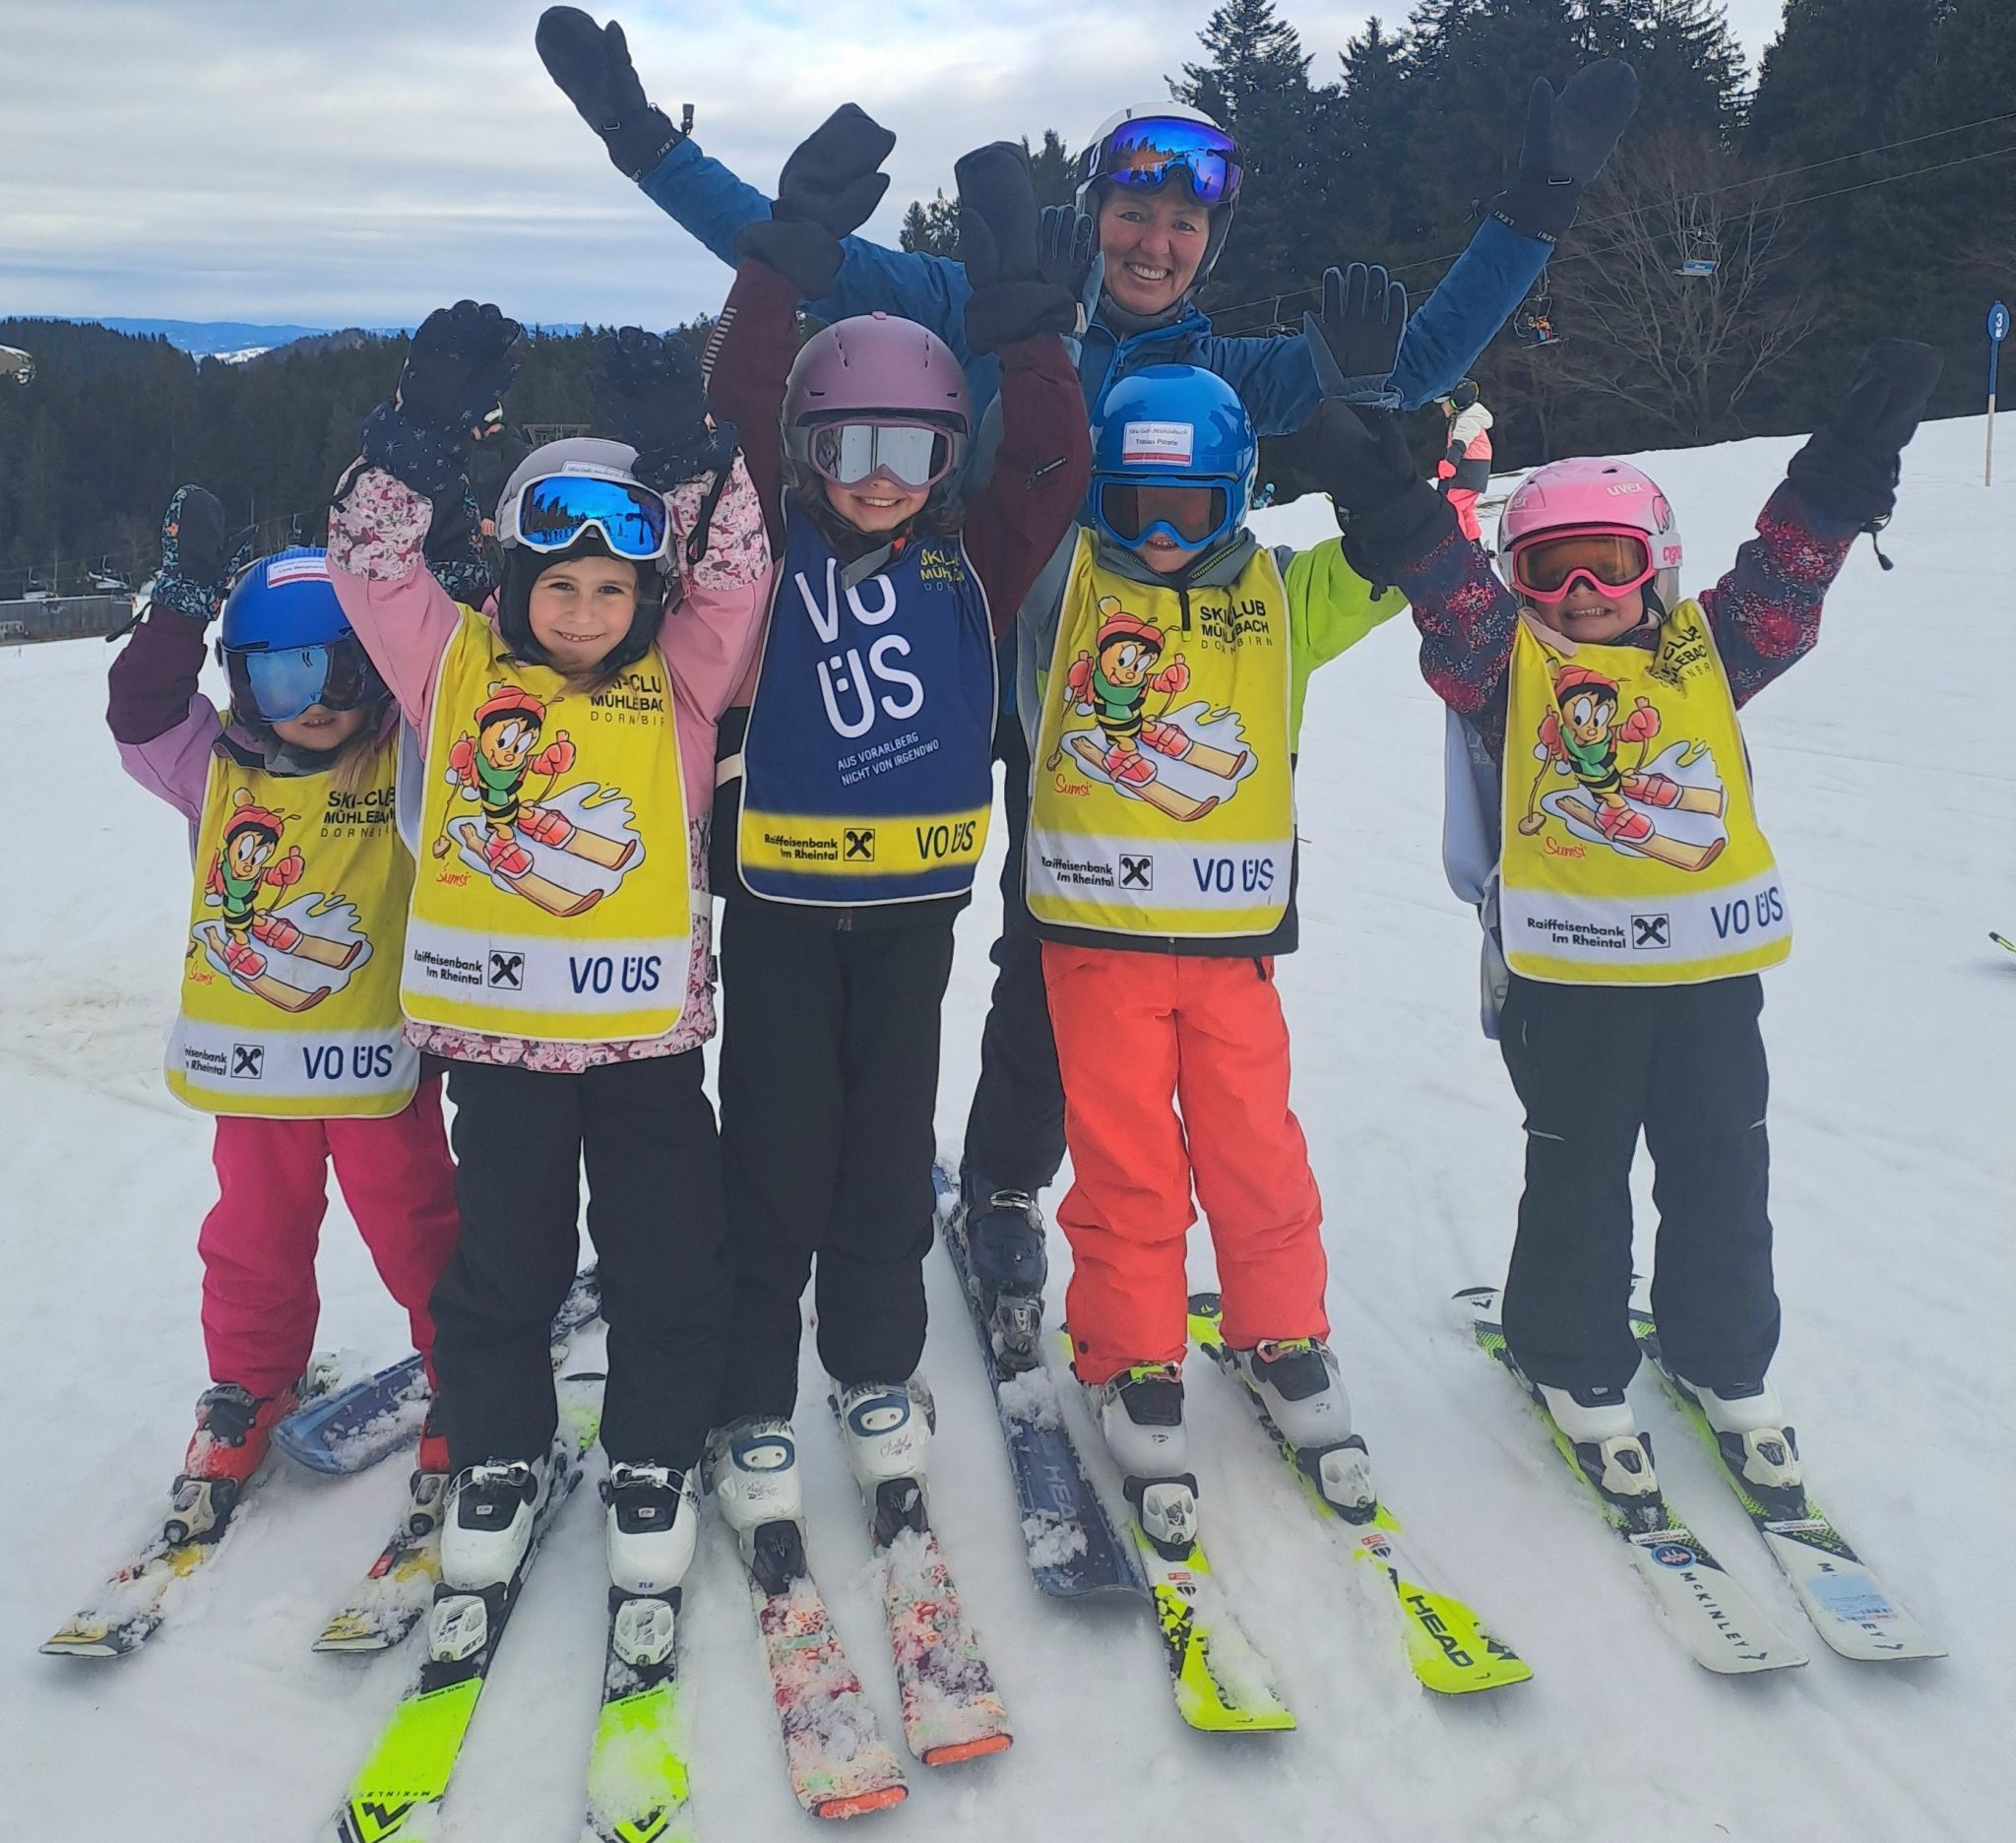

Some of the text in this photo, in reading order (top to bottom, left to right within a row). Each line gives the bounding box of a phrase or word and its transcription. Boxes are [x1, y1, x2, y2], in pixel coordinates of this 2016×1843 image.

[1606, 481, 1645, 496] uvex
[794, 557, 898, 644] VO
[816, 634, 925, 739] ÜS
[837, 731, 919, 772] AUS VORARLBERG
[841, 738, 939, 787] NICHT VON IRGENDWO
[1053, 774, 1094, 796] Sumsi
[764, 834, 838, 850] Raiffeisenbank
[794, 849, 838, 860] Rheintal
[1543, 836, 1588, 859] Sumsi
[1056, 871, 1114, 888] Im Rheintal
[1192, 858, 1235, 893] VO
[1527, 917, 1625, 937] Raiffeisenbank
[1711, 899, 1749, 939] VO
[1551, 933, 1626, 949] Im Rheintal
[426, 966, 483, 985] Im Rheintal
[569, 956, 613, 993] VO
[190, 1059, 227, 1076] Rheintal
[302, 1046, 344, 1080] VO
[1043, 1465, 1078, 1520] HEA
[1679, 1571, 1750, 1648] McKINLEY
[1406, 1594, 1476, 1668] HEAD
